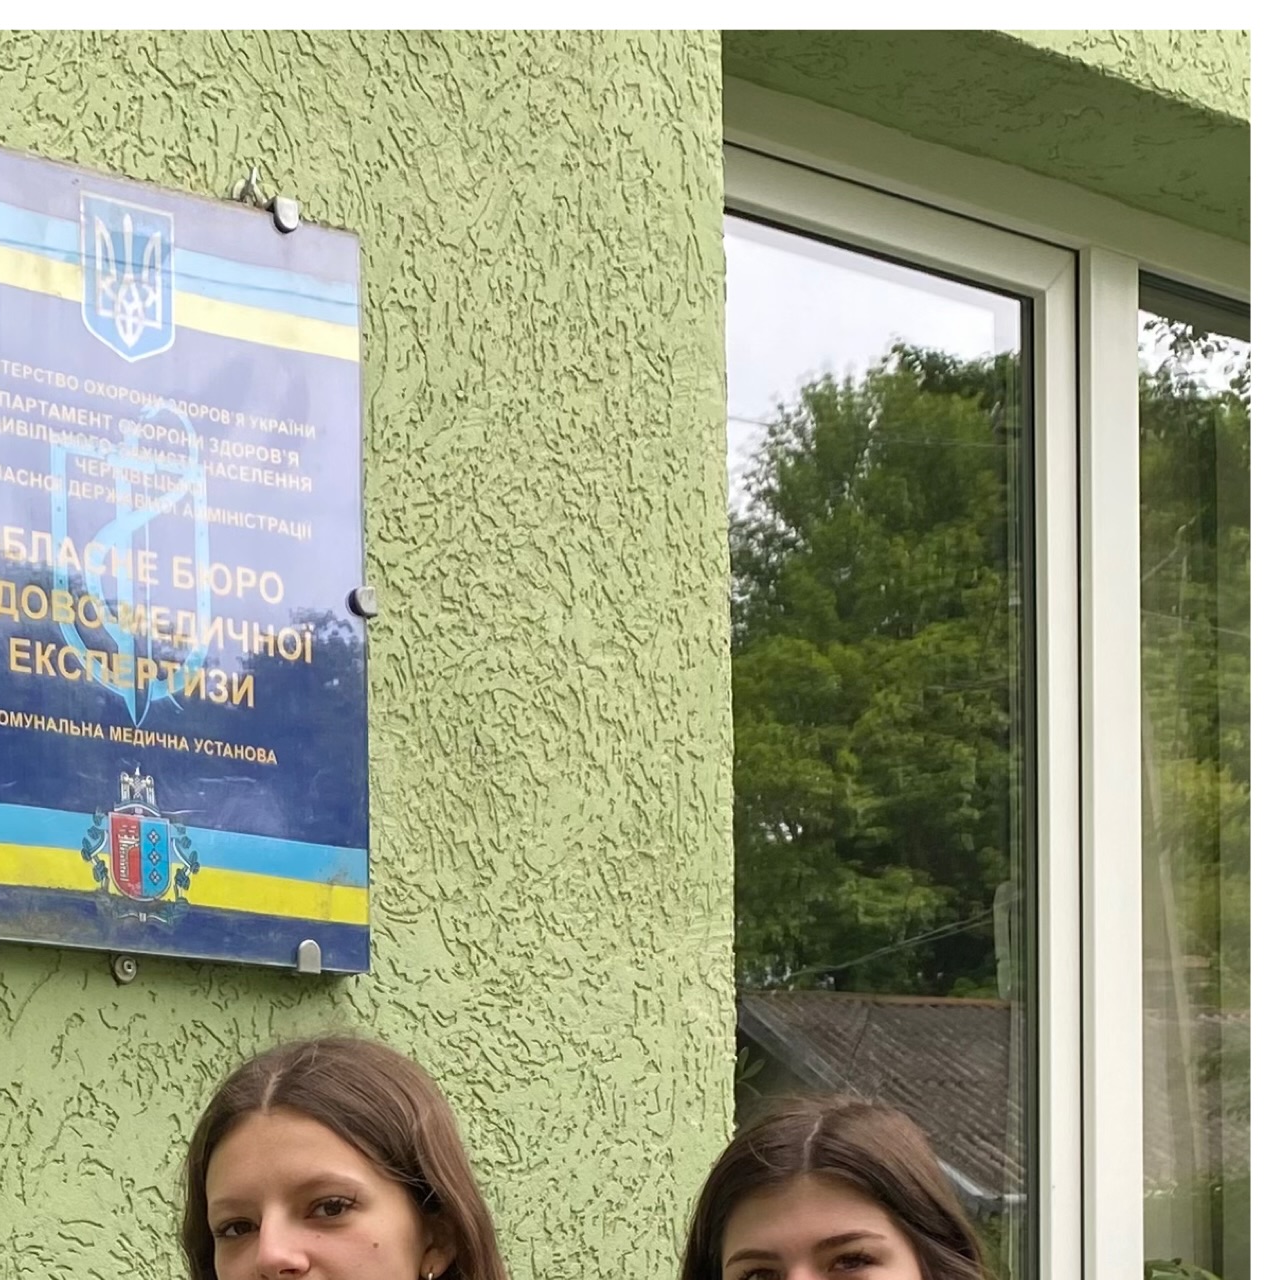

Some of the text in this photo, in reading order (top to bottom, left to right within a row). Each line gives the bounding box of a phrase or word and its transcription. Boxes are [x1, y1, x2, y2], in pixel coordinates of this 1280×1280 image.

[84, 379, 164, 408] ОХОРОНИ
[248, 415, 316, 440] УКРАЇНИ
[209, 437, 300, 467] ЗДОРОВ'Я
[203, 460, 313, 493] НАСЕЛЕННЯ
[172, 555, 285, 605] БЮРО
[8, 637, 255, 709] ЕКСПЕРТИЗИ
[109, 725, 190, 752] МЕДИЧНА
[193, 737, 278, 765] УСТАНОВА
